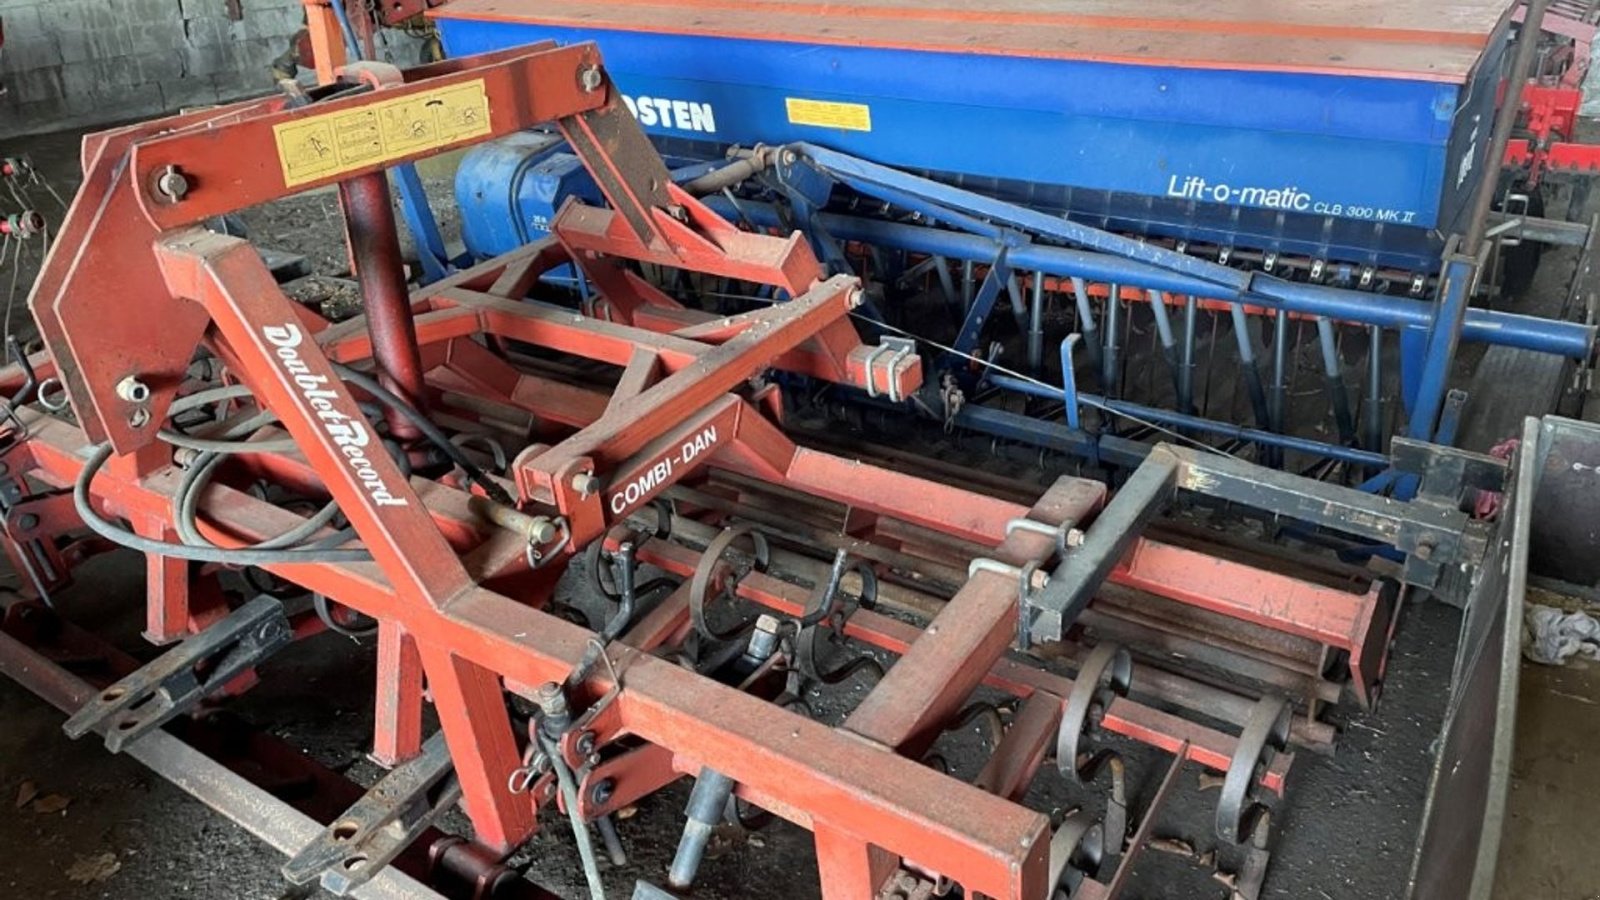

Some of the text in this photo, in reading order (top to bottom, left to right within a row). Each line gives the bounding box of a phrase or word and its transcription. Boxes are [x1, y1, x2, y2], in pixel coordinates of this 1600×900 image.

[1167, 175, 1311, 210] Lift-o-matic
[1313, 202, 1343, 216] CLB
[1346, 206, 1374, 219] 300
[1375, 209, 1400, 222] MK
